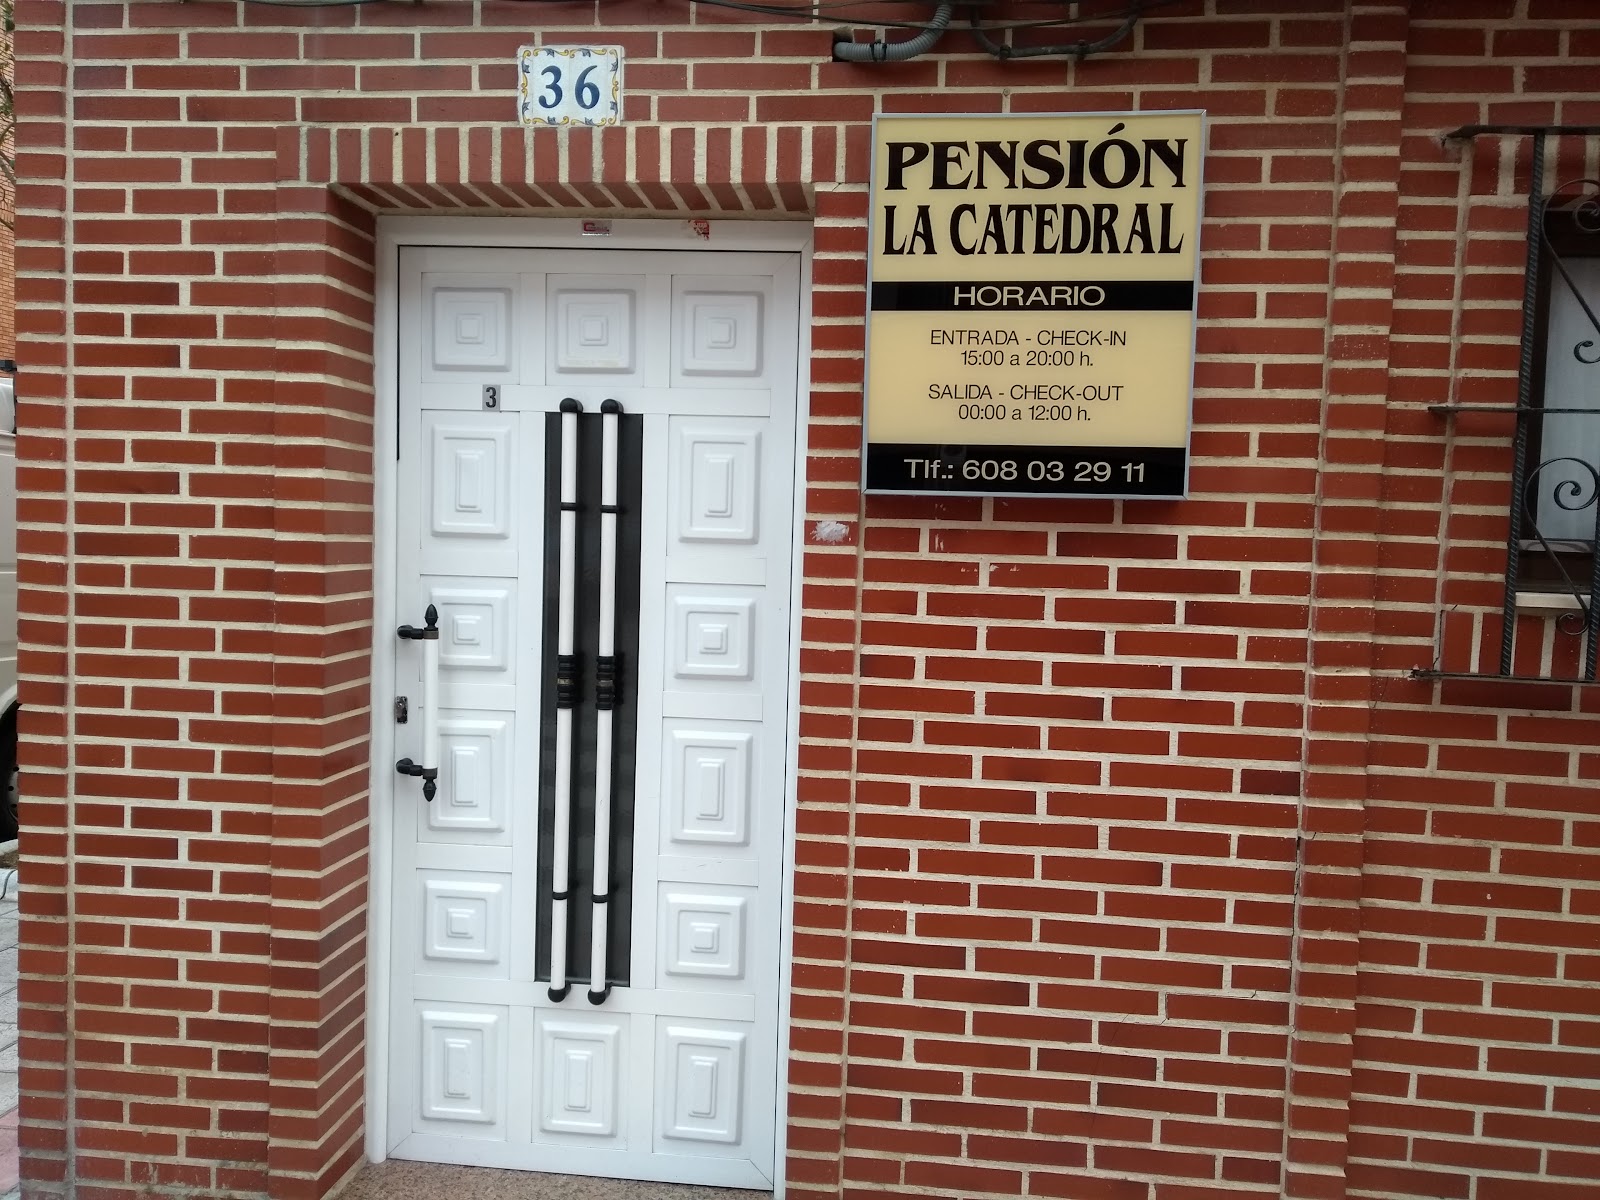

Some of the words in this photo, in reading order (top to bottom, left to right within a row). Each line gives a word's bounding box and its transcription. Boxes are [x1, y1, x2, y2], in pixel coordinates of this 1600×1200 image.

[538, 65, 600, 109] 36
[884, 122, 1188, 190] PENSIÓN
[882, 204, 937, 255] LA
[950, 202, 1184, 256] CATEDRAL
[953, 285, 1106, 306] HORARIO
[930, 329, 1019, 346] ENTRADA
[1037, 330, 1127, 346] CHECK-IN
[961, 350, 1004, 366] 15:00
[1010, 354, 1020, 366] a
[1026, 350, 1075, 367] 20:00
[1080, 351, 1094, 367] h.
[485, 386, 497, 408] 3
[928, 383, 992, 400] SALIDA
[1010, 384, 1124, 401] CHECK-OUT
[958, 404, 1006, 420] 00:00
[1011, 407, 1022, 420] a
[1028, 405, 1072, 421] 12:00
[1077, 405, 1091, 421] h.
[904, 459, 953, 479] Tlf.:
[962, 459, 1018, 481] 608
[1027, 460, 1065, 482] 03
[1073, 461, 1112, 482] 29
[1121, 462, 1145, 483] 11
